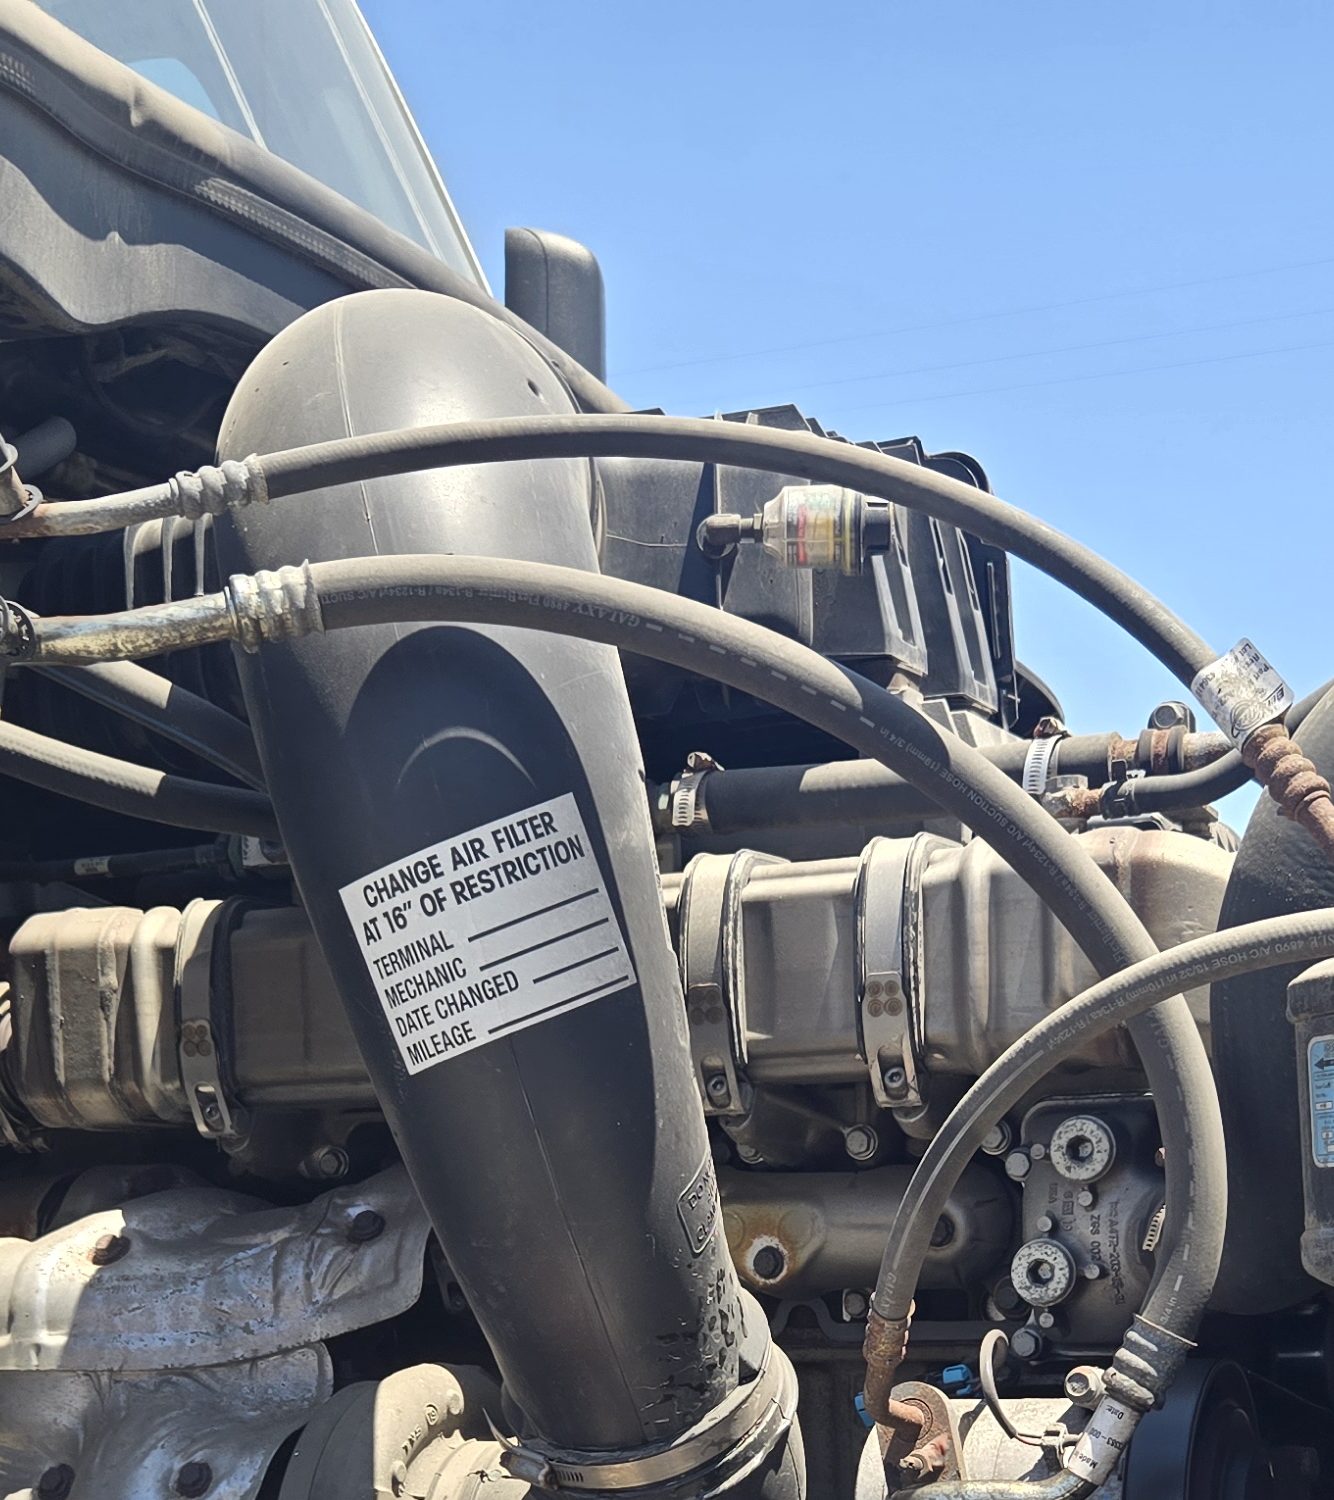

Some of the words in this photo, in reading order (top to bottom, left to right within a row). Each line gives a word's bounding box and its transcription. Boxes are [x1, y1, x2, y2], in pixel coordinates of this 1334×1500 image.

[434, 585, 474, 599] R-134a
[570, 600, 641, 628] GALAXY
[887, 734, 906, 753] 3/4
[938, 765, 968, 793] HOSE
[966, 785, 1008, 827] SUCTION
[363, 854, 445, 908] CHANGE
[449, 837, 489, 871] AIR
[492, 811, 558, 853] FILTER
[362, 917, 383, 946] AT
[420, 891, 447, 918] OF
[449, 834, 586, 905] RESTRICTION
[373, 930, 454, 980] TERMINAL
[1210, 950, 1247, 970] HOSE
[1248, 946, 1271, 960] A/C
[384, 957, 467, 1009] MECHANIC
[1165, 972, 1178, 985] in
[1177, 959, 1209, 980] 13/32
[395, 1004, 435, 1038] DATE
[436, 969, 520, 1021] CHANGED
[1090, 1000, 1125, 1019] R-134a
[406, 1021, 477, 1066] MILEAGE
[1090, 1241, 1101, 1261] 002
[1160, 1309, 1173, 1325] 3/4
[1169, 1296, 1178, 1307] in
[1078, 1453, 1098, 1469] Made
